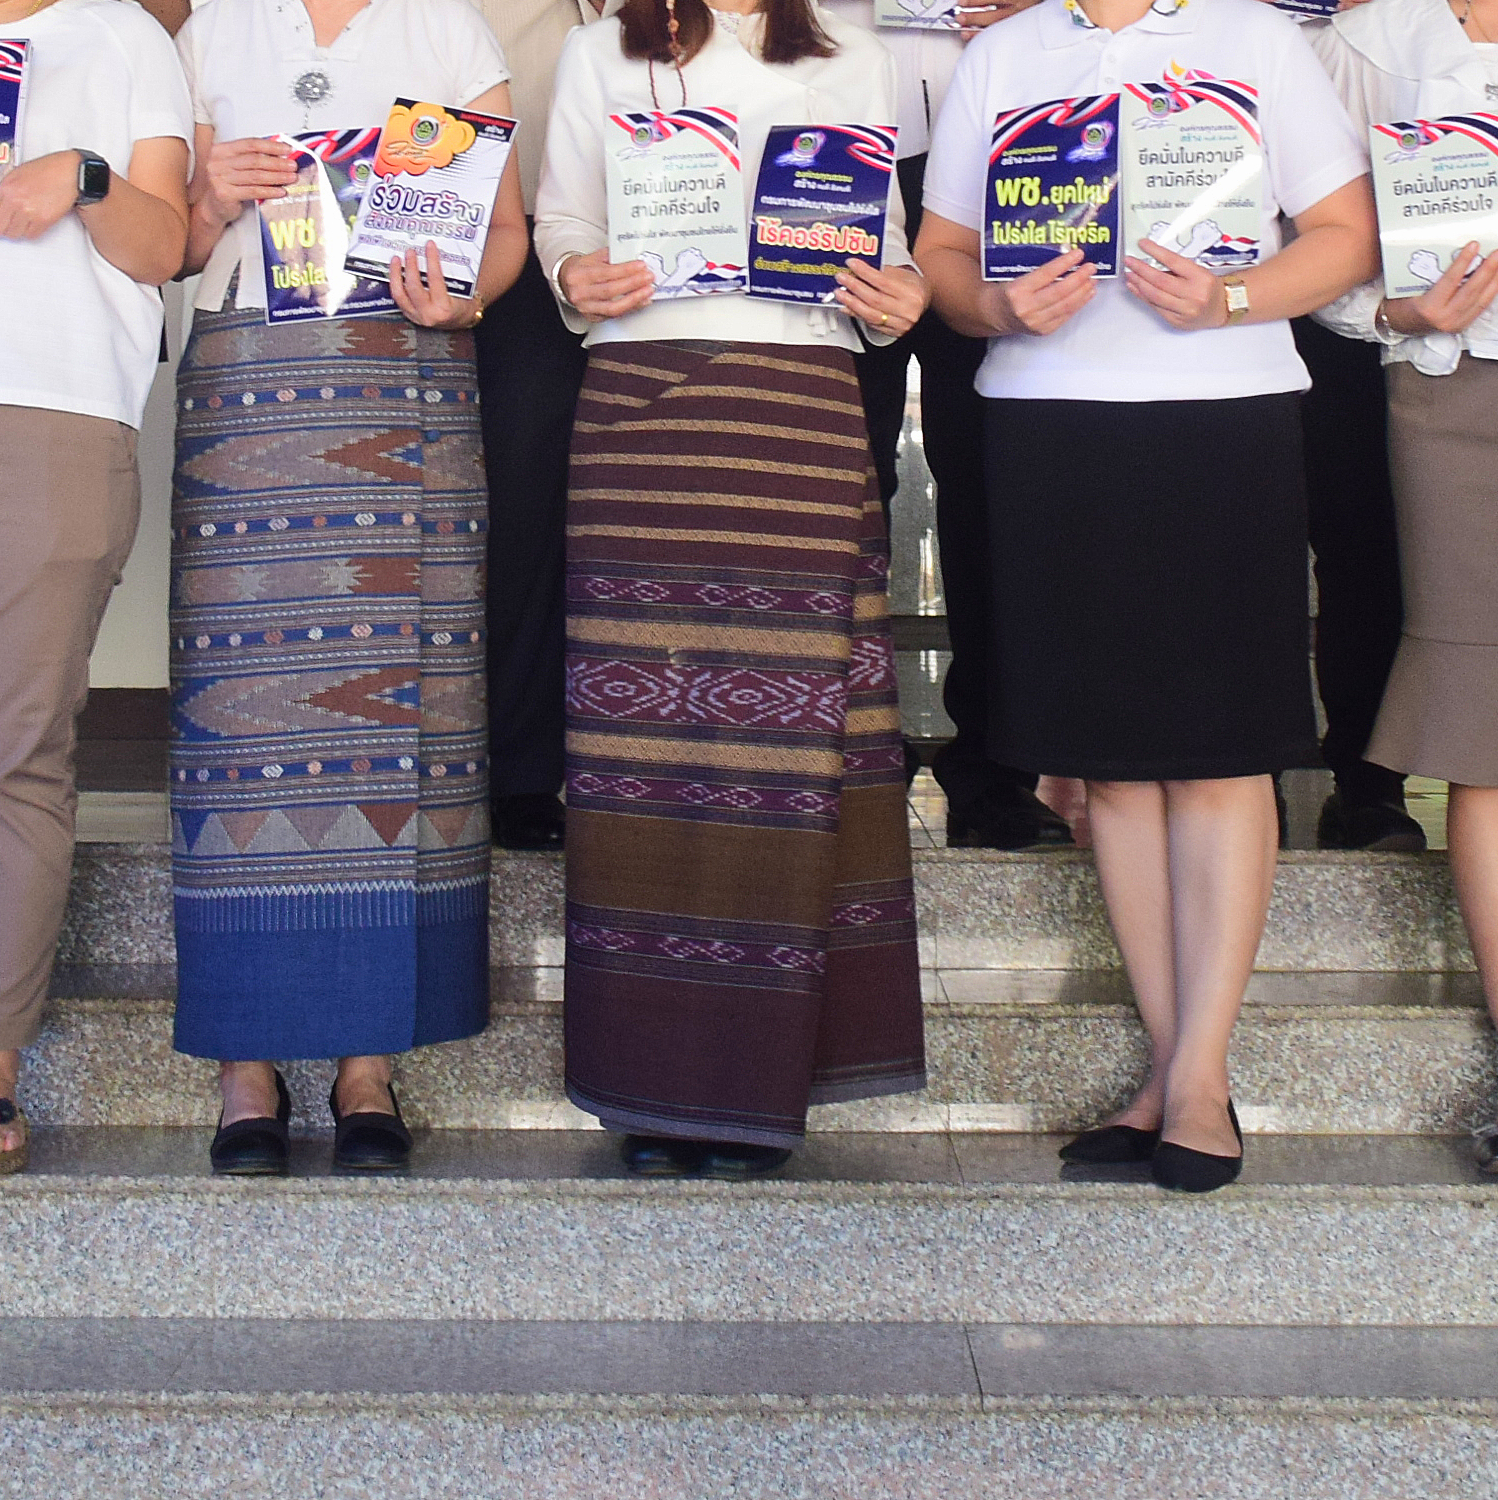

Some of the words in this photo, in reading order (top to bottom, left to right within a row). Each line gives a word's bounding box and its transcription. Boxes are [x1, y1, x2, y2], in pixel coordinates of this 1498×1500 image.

[1138, 144, 1245, 166] ยึดมั่นในความดี
[622, 172, 727, 196] ยึดมั่นในความดี
[1392, 171, 1498, 197] ยึดมั่นในความดี
[369, 173, 485, 227] ร่วมสร้าง
[631, 196, 720, 218] สามัคคีร่วมใจ
[1403, 195, 1493, 218] สามัคคีร่วมใจ
[364, 211, 480, 241] สังคมคุณธรรม
[755, 215, 880, 256] ไร้คอร์รัปชัน
[991, 220, 1048, 247] โปร่งใส
[1048, 221, 1111, 249] ไร้ทุจริต
